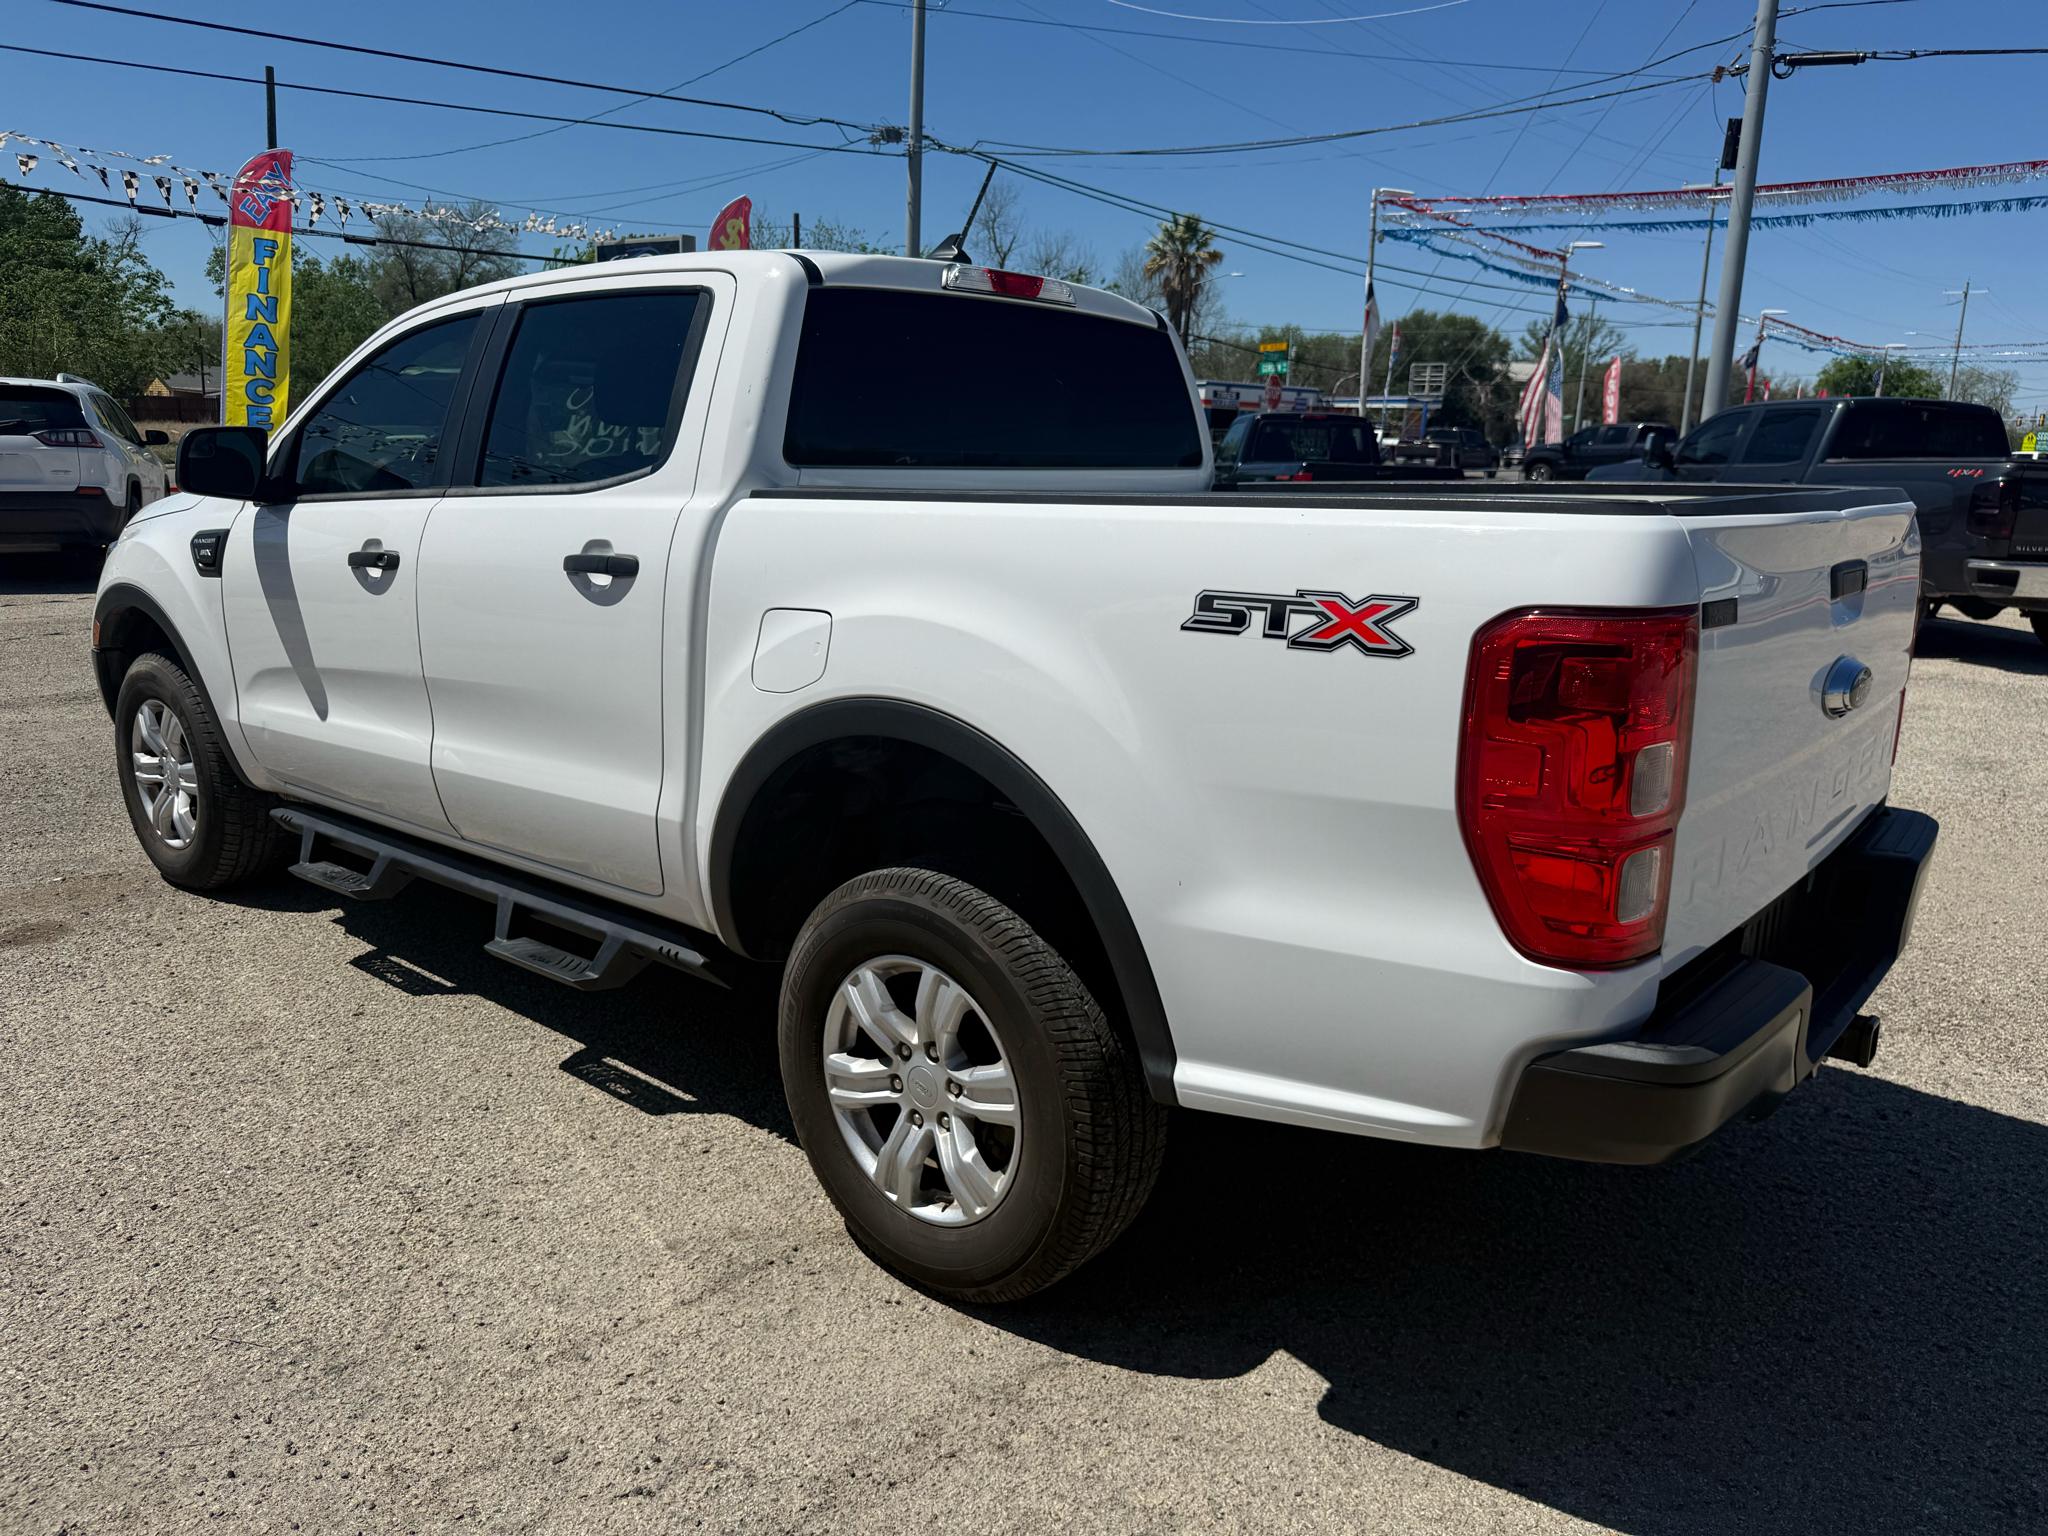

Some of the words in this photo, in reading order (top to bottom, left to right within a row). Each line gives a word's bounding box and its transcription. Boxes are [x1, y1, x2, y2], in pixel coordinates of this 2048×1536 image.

[239, 161, 290, 226] EASY
[244, 237, 279, 432] FINANCE
[1180, 589, 1420, 659] STX
